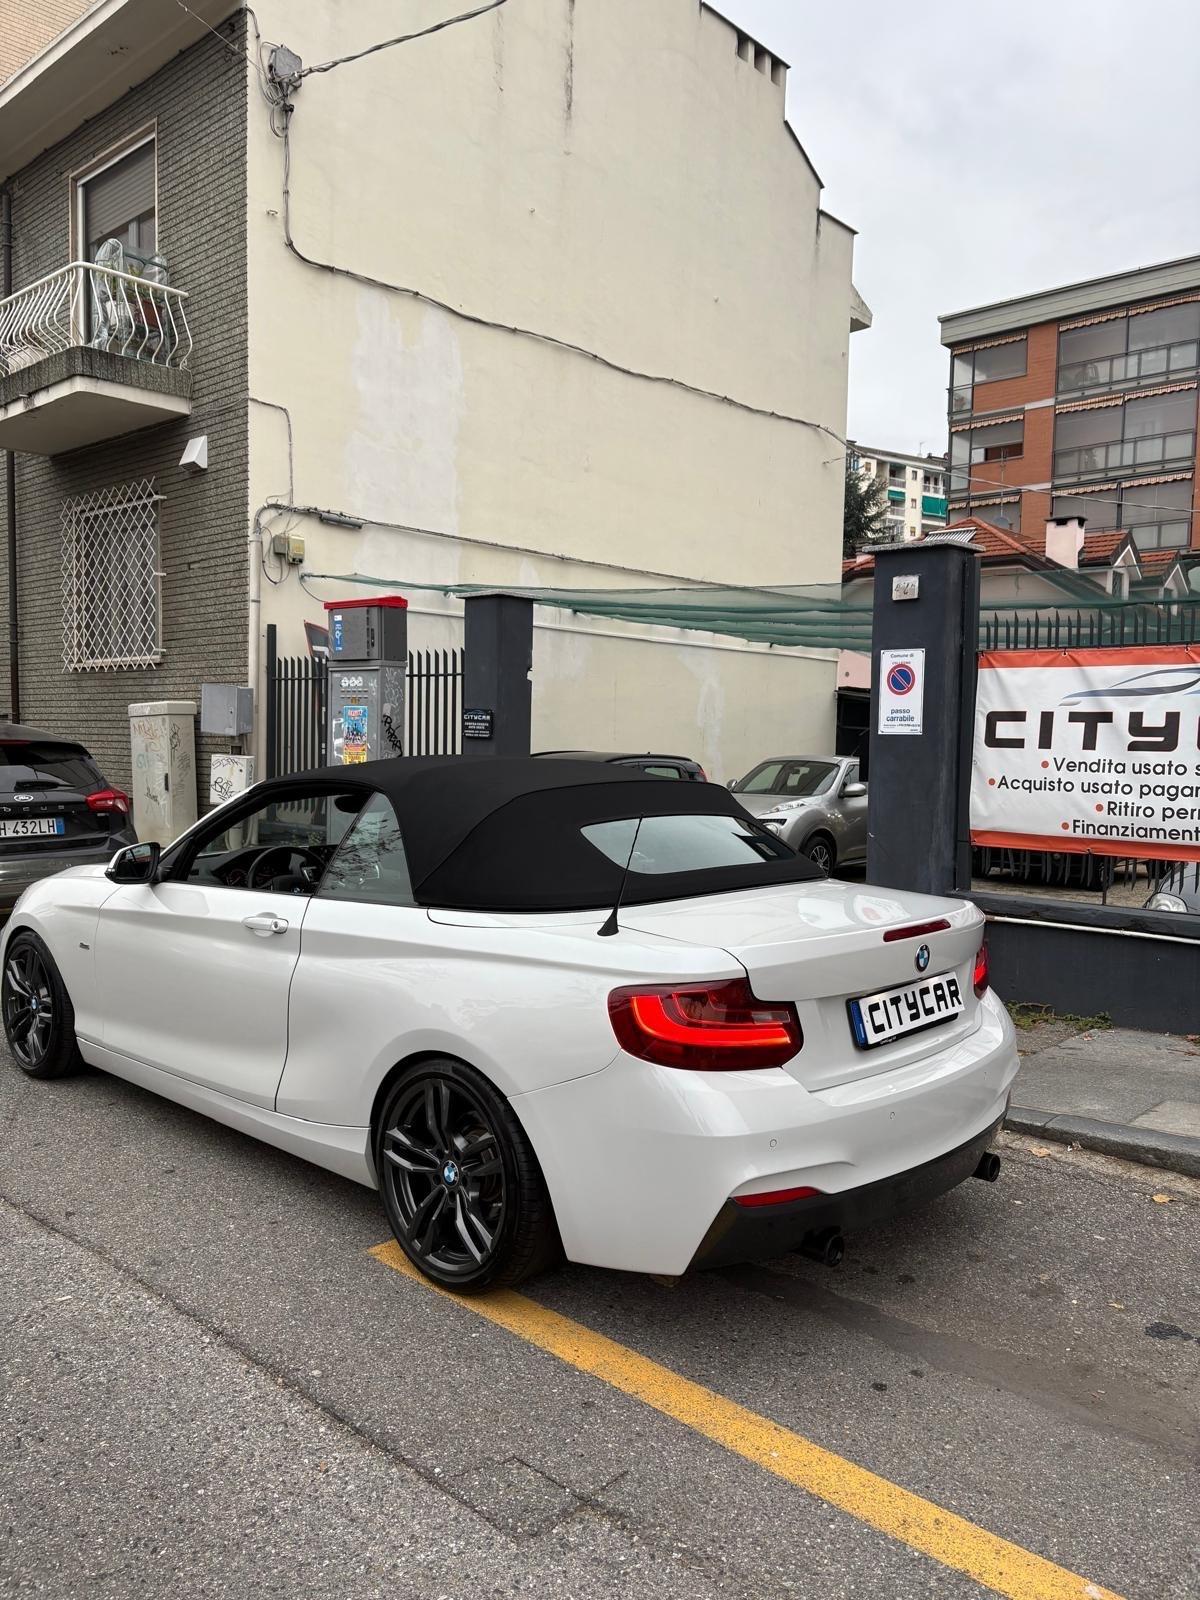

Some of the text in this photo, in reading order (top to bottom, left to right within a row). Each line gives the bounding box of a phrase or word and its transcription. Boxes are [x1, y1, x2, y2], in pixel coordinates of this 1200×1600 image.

[984, 711, 1200, 752] CITY
[1053, 757, 1126, 774] Vendita
[1131, 760, 1188, 776] usato
[997, 775, 1075, 794] Acquisto
[1080, 780, 1133, 796] usato
[1107, 801, 1200, 822] Ritiro per
[1072, 819, 1200, 842] Finanziament
[868, 978, 962, 1035] CITYCAR
